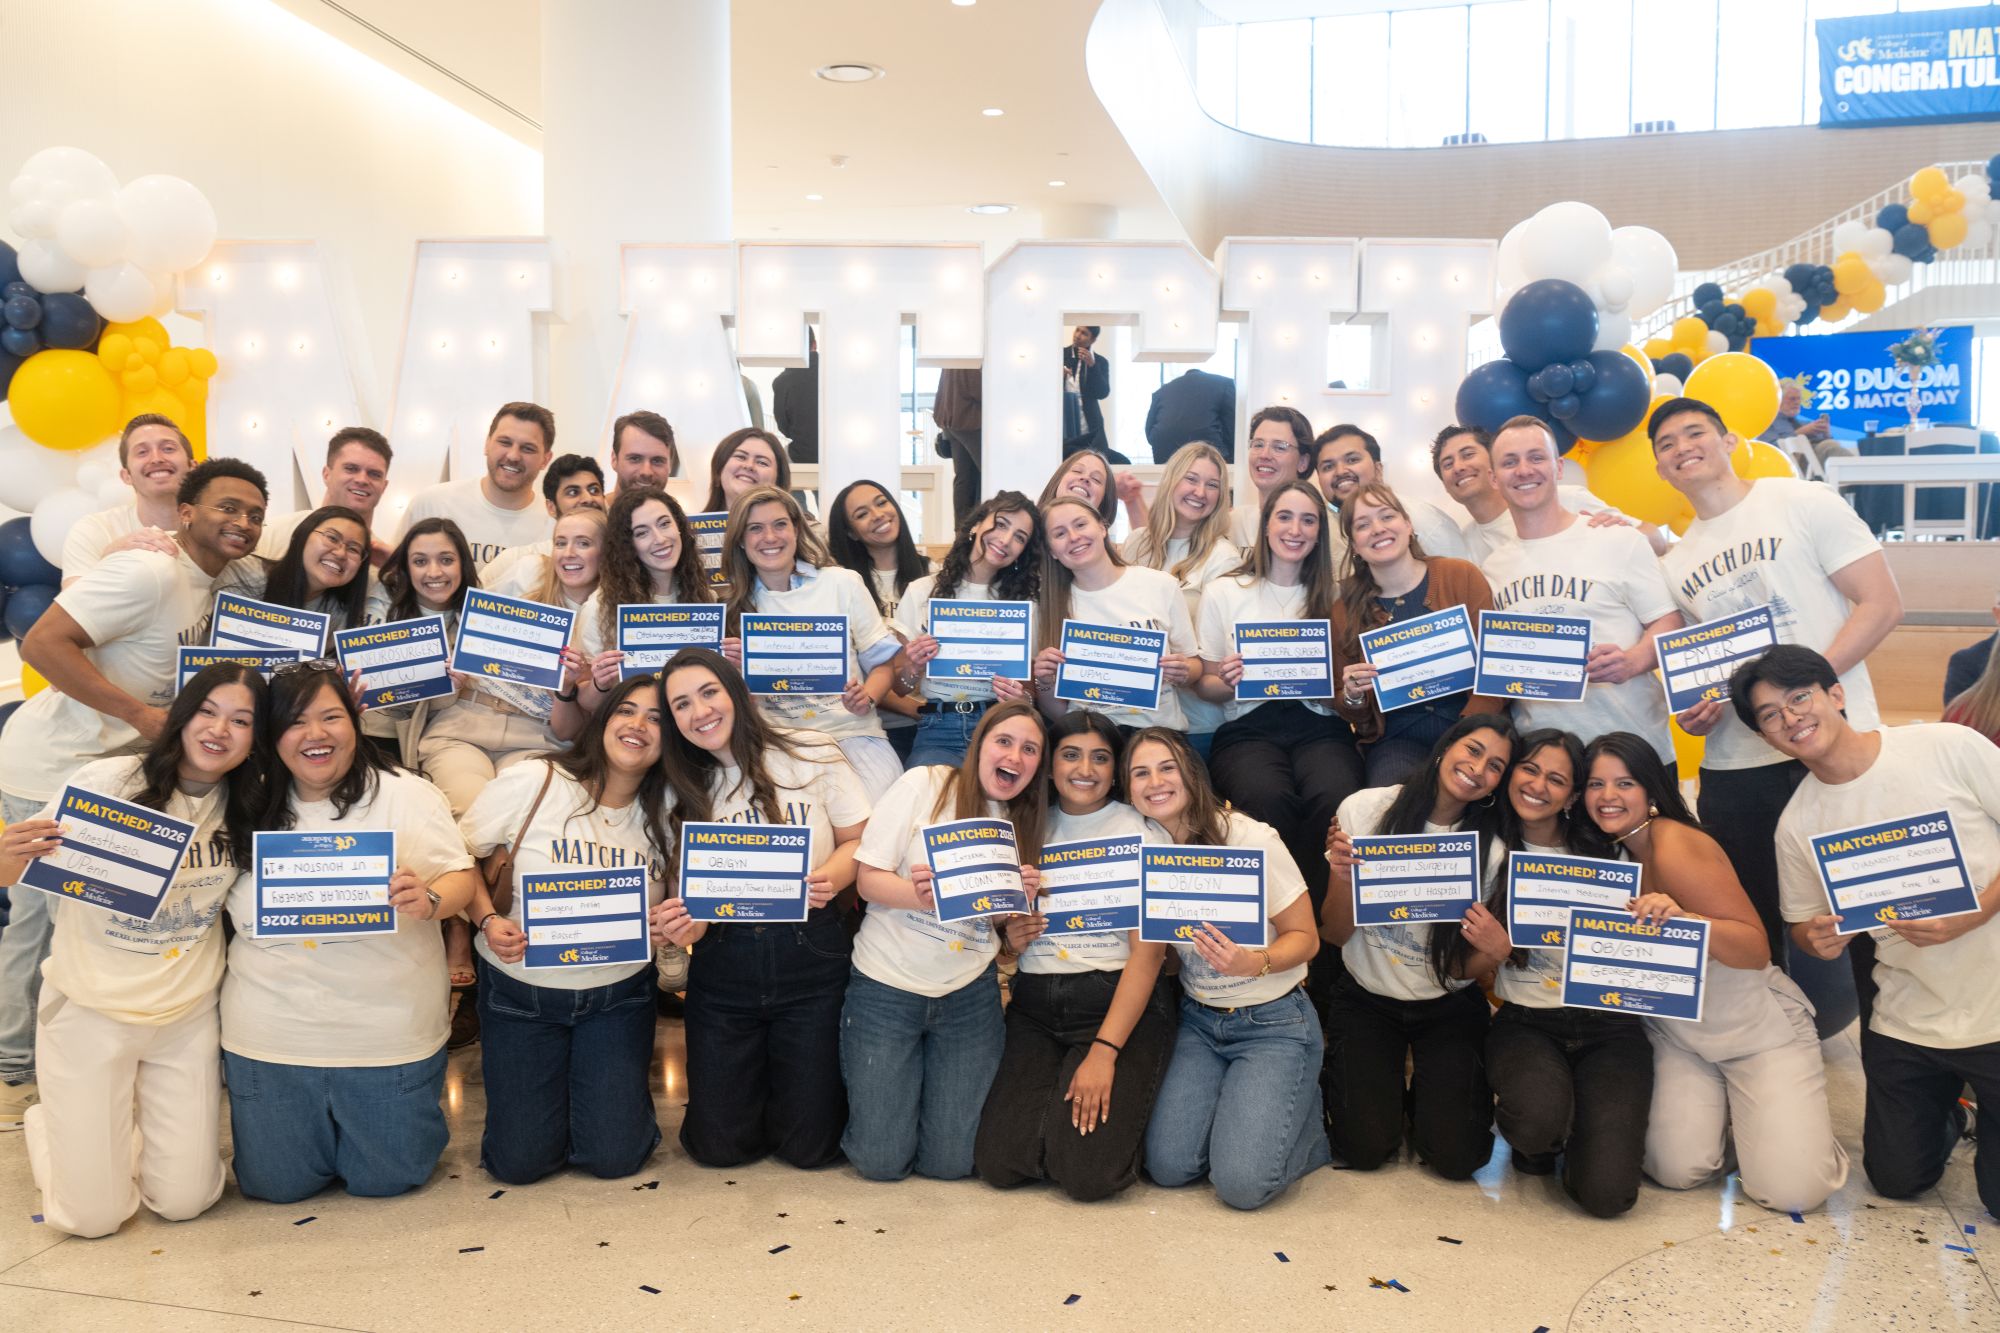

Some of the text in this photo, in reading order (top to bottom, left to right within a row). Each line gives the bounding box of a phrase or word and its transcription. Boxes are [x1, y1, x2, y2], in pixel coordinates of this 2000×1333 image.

[1834, 57, 2000, 95] CONGRATUL
[1816, 368, 1851, 390] 20
[1854, 364, 1960, 392] DUCOM
[1816, 389, 1851, 411] 26
[1921, 389, 1960, 406] DAY
[1681, 537, 1783, 603] MATCH DAY
[1494, 574, 1594, 611] MATCH DAY
[221, 601, 321, 629] I MATCHED! 2026
[470, 597, 567, 626] I MATCHED! 2026
[623, 612, 719, 622] I MATCHED! 2026
[934, 607, 937, 615] I
[999, 609, 1025, 617] 2026
[753, 622, 812, 630] MATCHED!
[815, 622, 843, 631] 2026
[1246, 628, 1298, 636] MATCHED!
[1300, 628, 1325, 636] 2026
[1367, 641, 1373, 649] I
[1374, 626, 1432, 645] MATCHED!
[1434, 614, 1463, 629] 2026
[1484, 620, 1586, 635] I MATCHED! 2026
[1662, 642, 1668, 650] I
[1669, 624, 1734, 647] MATCHED!
[1736, 613, 1767, 630] 2026
[341, 624, 439, 648] I MATCHED! 2026
[763, 640, 794, 649] Internal
[1068, 628, 1160, 647] I MATCHED! 2026
[184, 656, 190, 666] I
[1080, 647, 1113, 659] Internal
[1079, 669, 1111, 680] UPMC
[65, 796, 185, 842] I MATCHED! 2026
[77, 826, 142, 857] Anesthesia
[689, 832, 805, 845] I MATCHED! 2026
[929, 836, 934, 845] I
[937, 827, 998, 843] MATCHED!
[1819, 820, 1947, 855] I MATCHED! 2026
[551, 838, 625, 869] MATCH
[1043, 847, 1105, 862] MATCHED!
[1107, 843, 1138, 855] 2026
[1357, 841, 1471, 855] I MATCHED! 2026
[65, 852, 110, 878] UPenn
[293, 861, 365, 872] UT HOUSTON
[707, 856, 747, 870] OB/GYN
[1146, 855, 1259, 868] I MATCHED! 2026
[1375, 859, 1458, 878] General Surgery
[1516, 862, 1632, 883] I MATCHED! 2026
[527, 876, 640, 893] I MATCHED! 2026
[958, 874, 994, 890] UCONN
[1168, 874, 1221, 891] OB/GYN
[82, 891, 115, 906] Medicine
[271, 888, 370, 901] VASCULAR SURGERY
[1377, 885, 1460, 899] Cooper U Hospital
[1165, 900, 1217, 919] Abington
[1899, 906, 1934, 919] Medicine
[261, 911, 388, 926] I MATCHED! 2026
[1086, 919, 1112, 928] Medicine
[105, 928, 132, 942] DREXEL
[551, 929, 583, 940] Bassett
[1575, 917, 1700, 940] I MATCHED! 2026
[1091, 941, 1121, 949] MEDICINE
[1590, 940, 1653, 960] OB/GYN
[580, 954, 609, 962] Medicine
